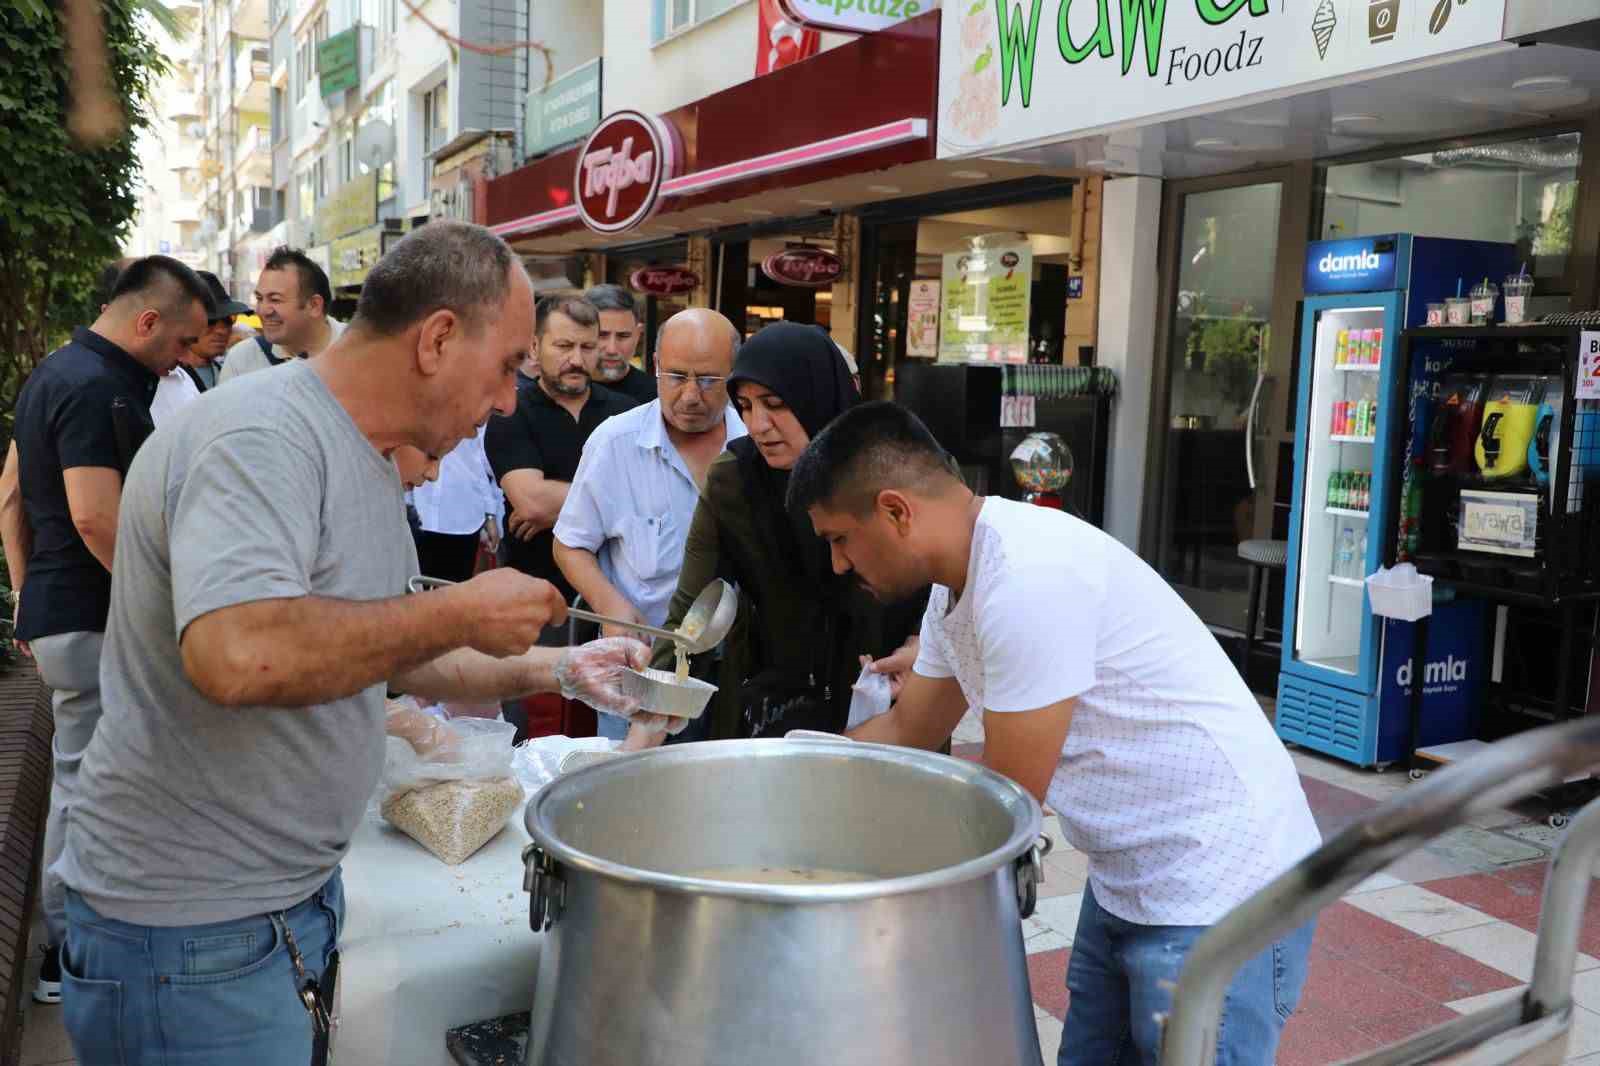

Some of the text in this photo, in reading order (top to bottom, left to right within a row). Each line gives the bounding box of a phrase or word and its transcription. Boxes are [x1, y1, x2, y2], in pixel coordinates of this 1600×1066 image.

[1164, 30, 1265, 86] Foodz
[1319, 247, 1379, 273] damla
[1396, 653, 1467, 686] dmla
